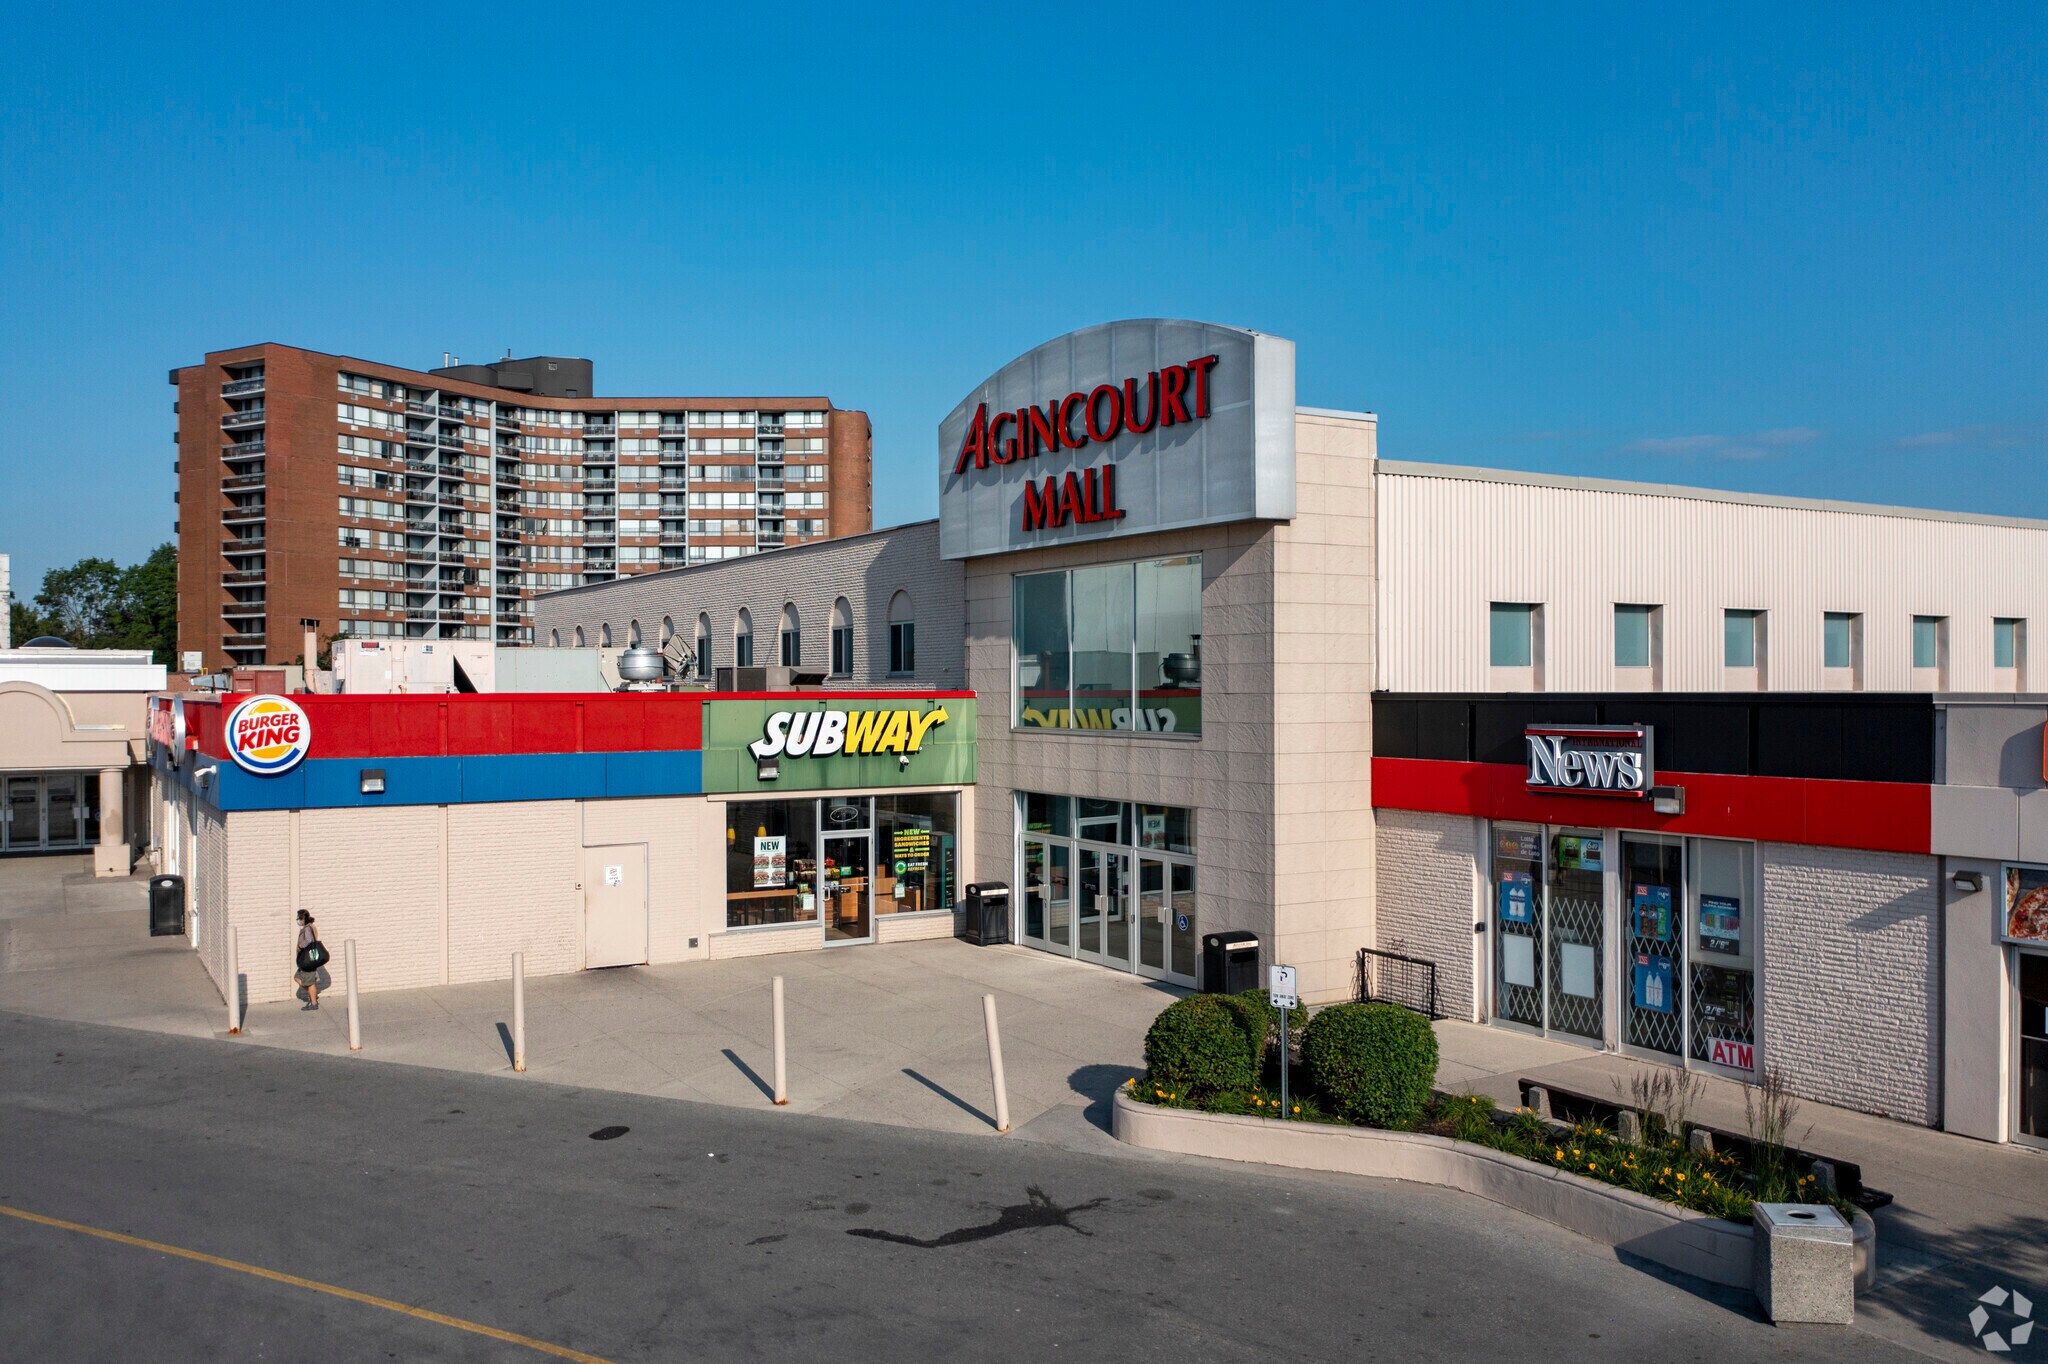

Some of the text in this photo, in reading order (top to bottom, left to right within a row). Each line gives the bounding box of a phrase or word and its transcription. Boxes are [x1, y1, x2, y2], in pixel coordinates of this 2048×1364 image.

[954, 353, 1219, 475] AGINCOURT
[1021, 463, 1127, 532] MALL
[238, 713, 299, 733] BURGER
[238, 726, 300, 752] KING
[749, 705, 950, 759] SUBWAY
[1525, 735, 1643, 790] News
[760, 841, 780, 851] NEW
[1712, 1040, 1754, 1069] ATM
